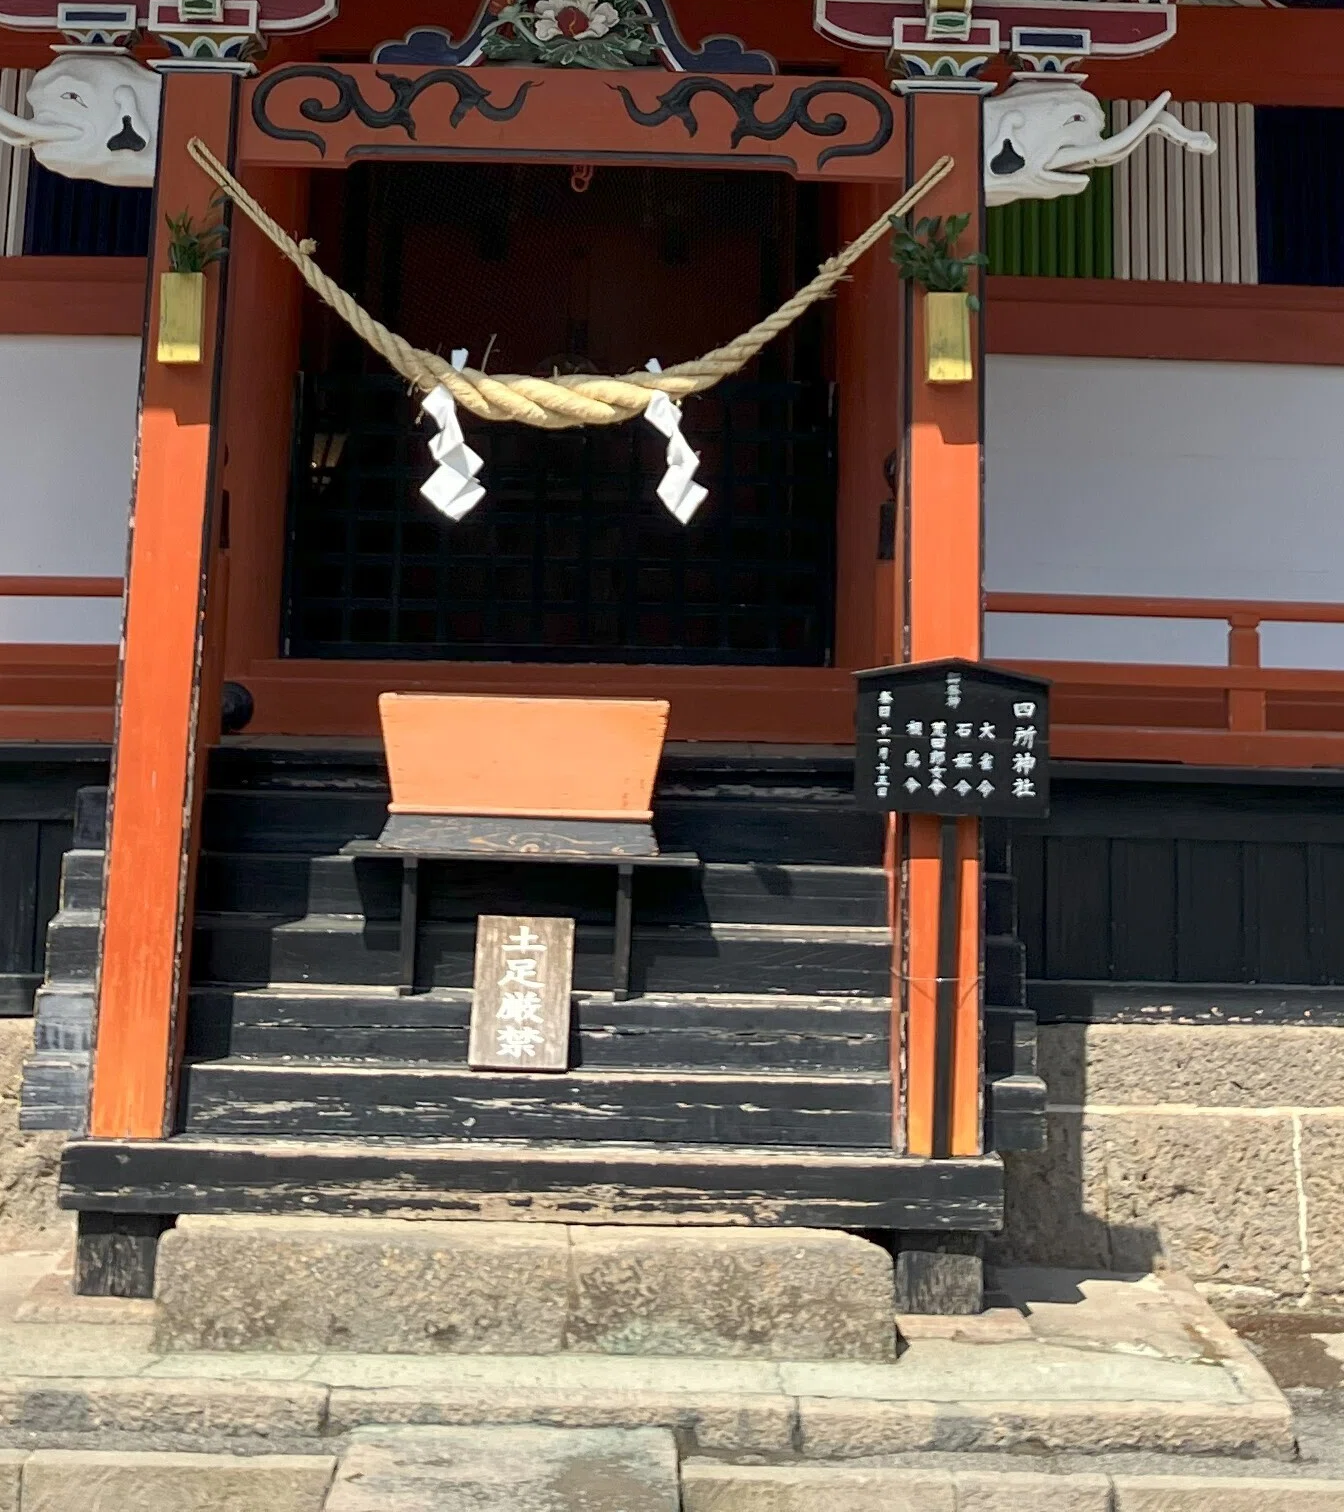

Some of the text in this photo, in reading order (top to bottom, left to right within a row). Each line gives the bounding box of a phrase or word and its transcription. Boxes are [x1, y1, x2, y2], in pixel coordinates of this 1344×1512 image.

[1012, 702, 1038, 798] 四所神社
[496, 926, 548, 1058] 土足厳禁
